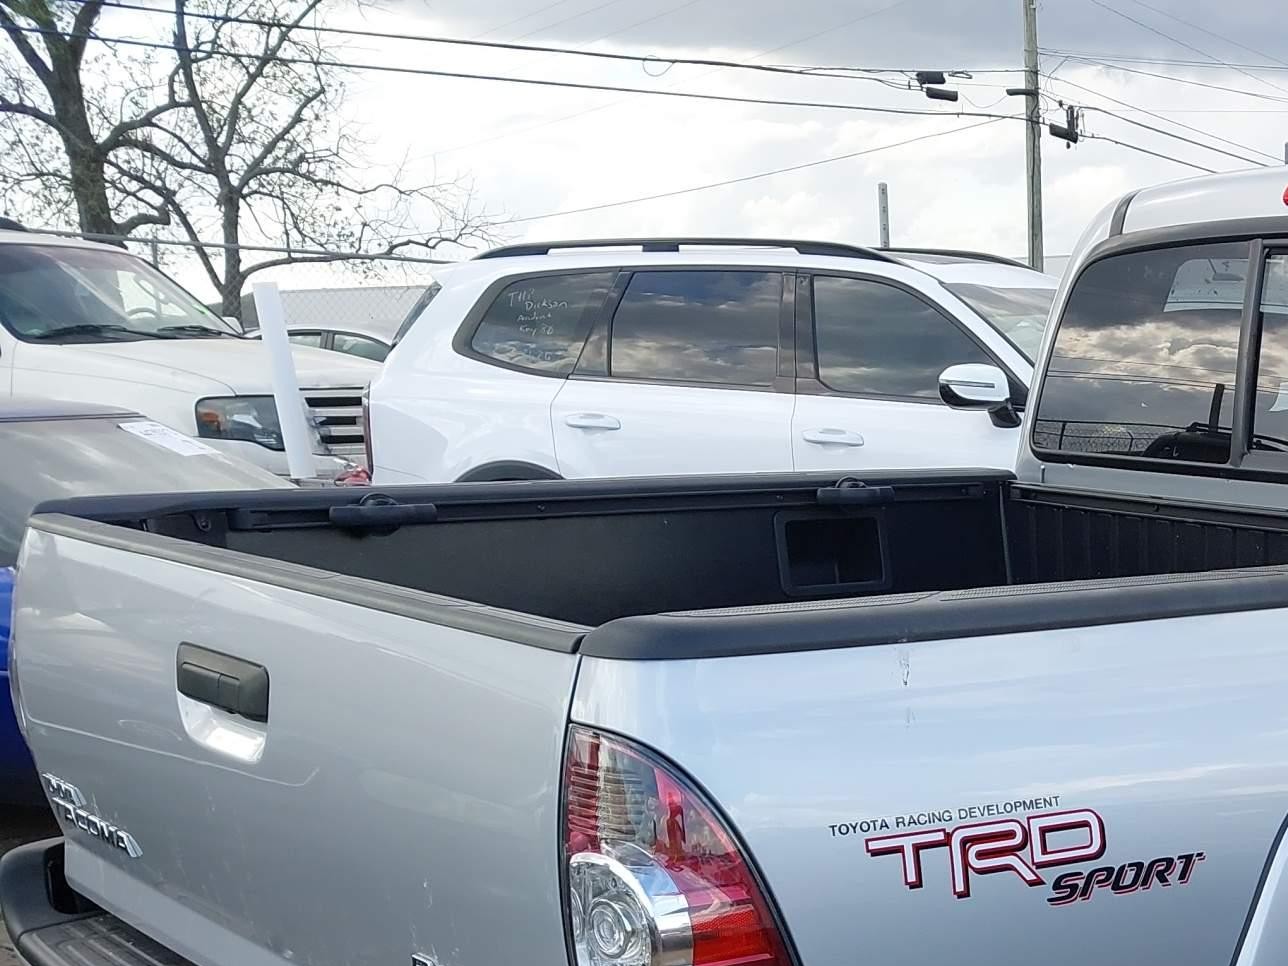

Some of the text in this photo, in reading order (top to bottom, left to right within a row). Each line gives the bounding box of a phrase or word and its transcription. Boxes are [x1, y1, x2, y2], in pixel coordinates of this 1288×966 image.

[52, 797, 143, 857] TACOMA
[829, 796, 1061, 837] TOYOTA RACING DEVELOPMENT
[864, 808, 1206, 906] TRD SPORT
